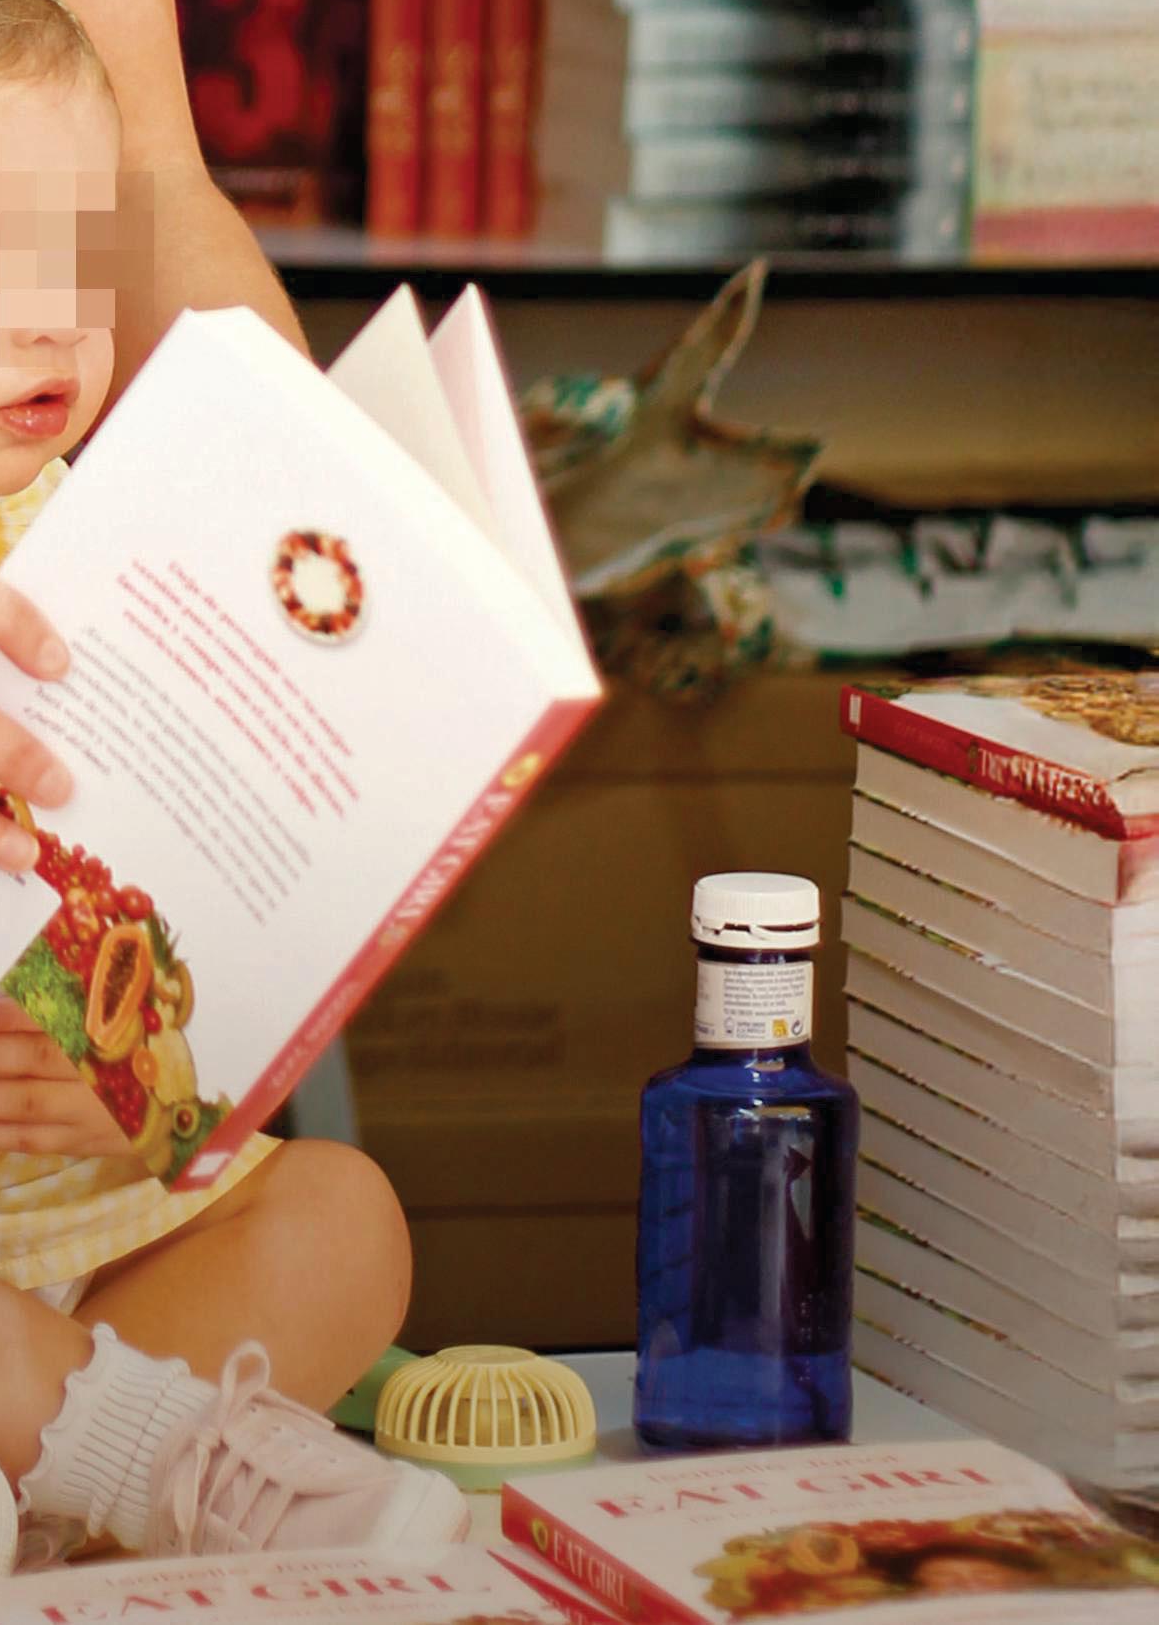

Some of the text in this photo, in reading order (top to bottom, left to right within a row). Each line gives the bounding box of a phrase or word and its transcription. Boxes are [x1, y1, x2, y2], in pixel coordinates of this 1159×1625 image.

[595, 1483, 770, 1518] EAT
[796, 1467, 1020, 1494] GIRL
[553, 1529, 626, 1608] EAT GIRL
[42, 1586, 224, 1624] EAT
[251, 1574, 492, 1600] GIRL
